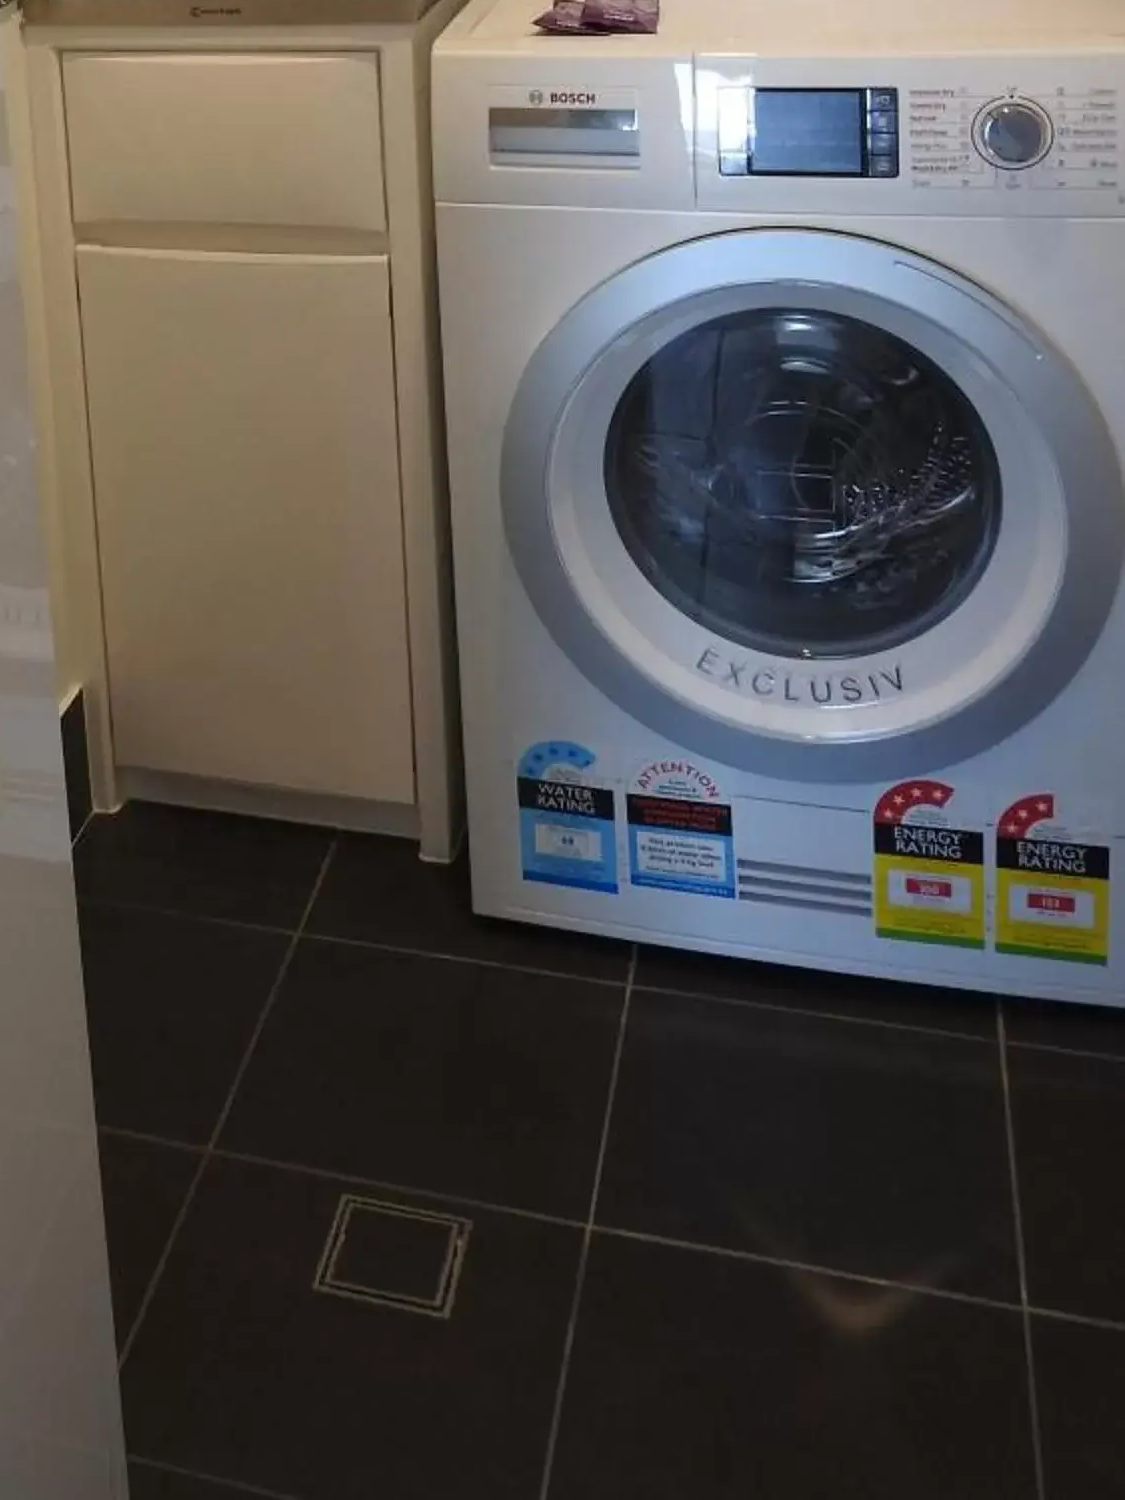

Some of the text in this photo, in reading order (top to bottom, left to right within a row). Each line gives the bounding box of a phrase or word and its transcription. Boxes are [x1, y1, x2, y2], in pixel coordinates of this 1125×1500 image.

[550, 92, 596, 105] BOSCH
[695, 647, 904, 704] EXCLUSIV
[636, 759, 720, 800] ATTENTION
[538, 783, 594, 801] WATER
[537, 795, 596, 815] RATING
[894, 825, 963, 846] ENERGY
[895, 839, 963, 859] RATING
[1016, 841, 1088, 860] ENERGY
[1018, 855, 1088, 874] RATING
